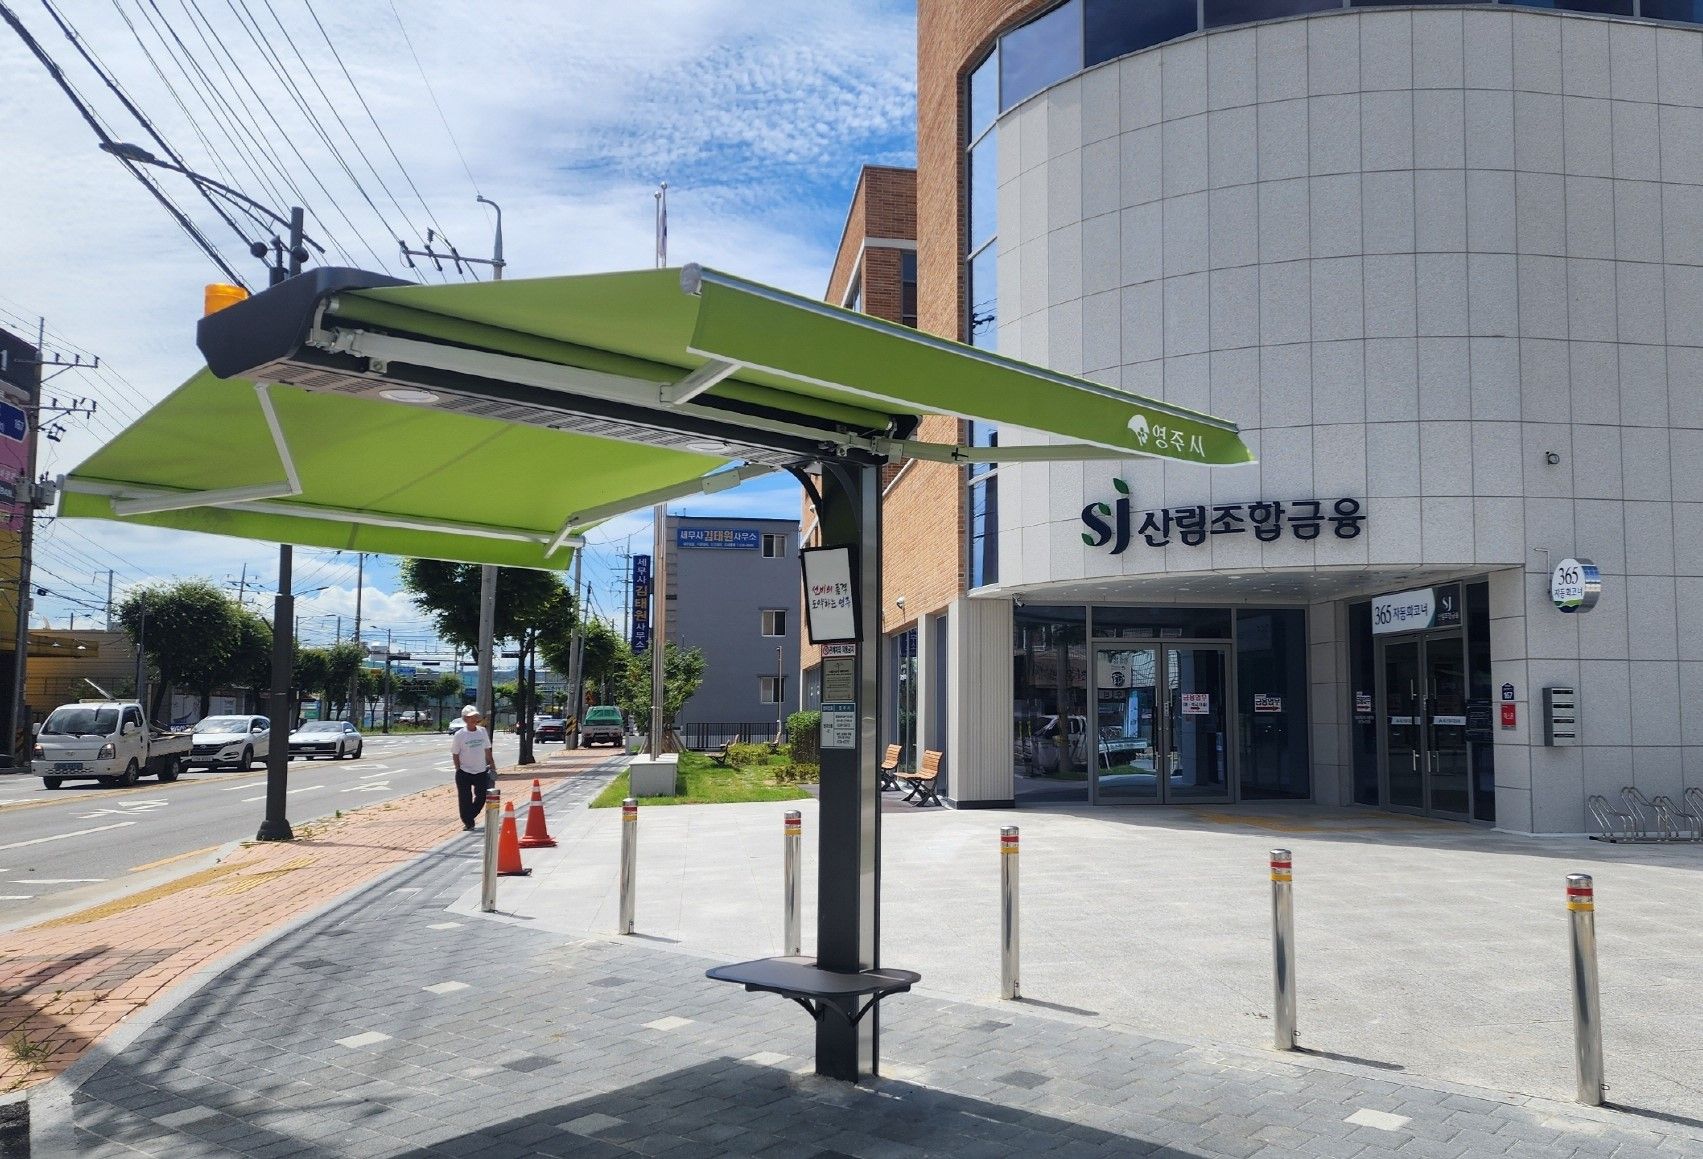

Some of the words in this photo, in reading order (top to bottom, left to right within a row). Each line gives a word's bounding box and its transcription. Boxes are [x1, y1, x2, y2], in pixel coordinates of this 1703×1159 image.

[1152, 424, 1205, 457] 영주시
[1138, 498, 1366, 547] 산림조합금융
[1558, 566, 1579, 585] 365
[1553, 586, 1583, 599] 자동화코너
[1374, 604, 1392, 625] 365
[1393, 603, 1428, 621] 자동화코너
